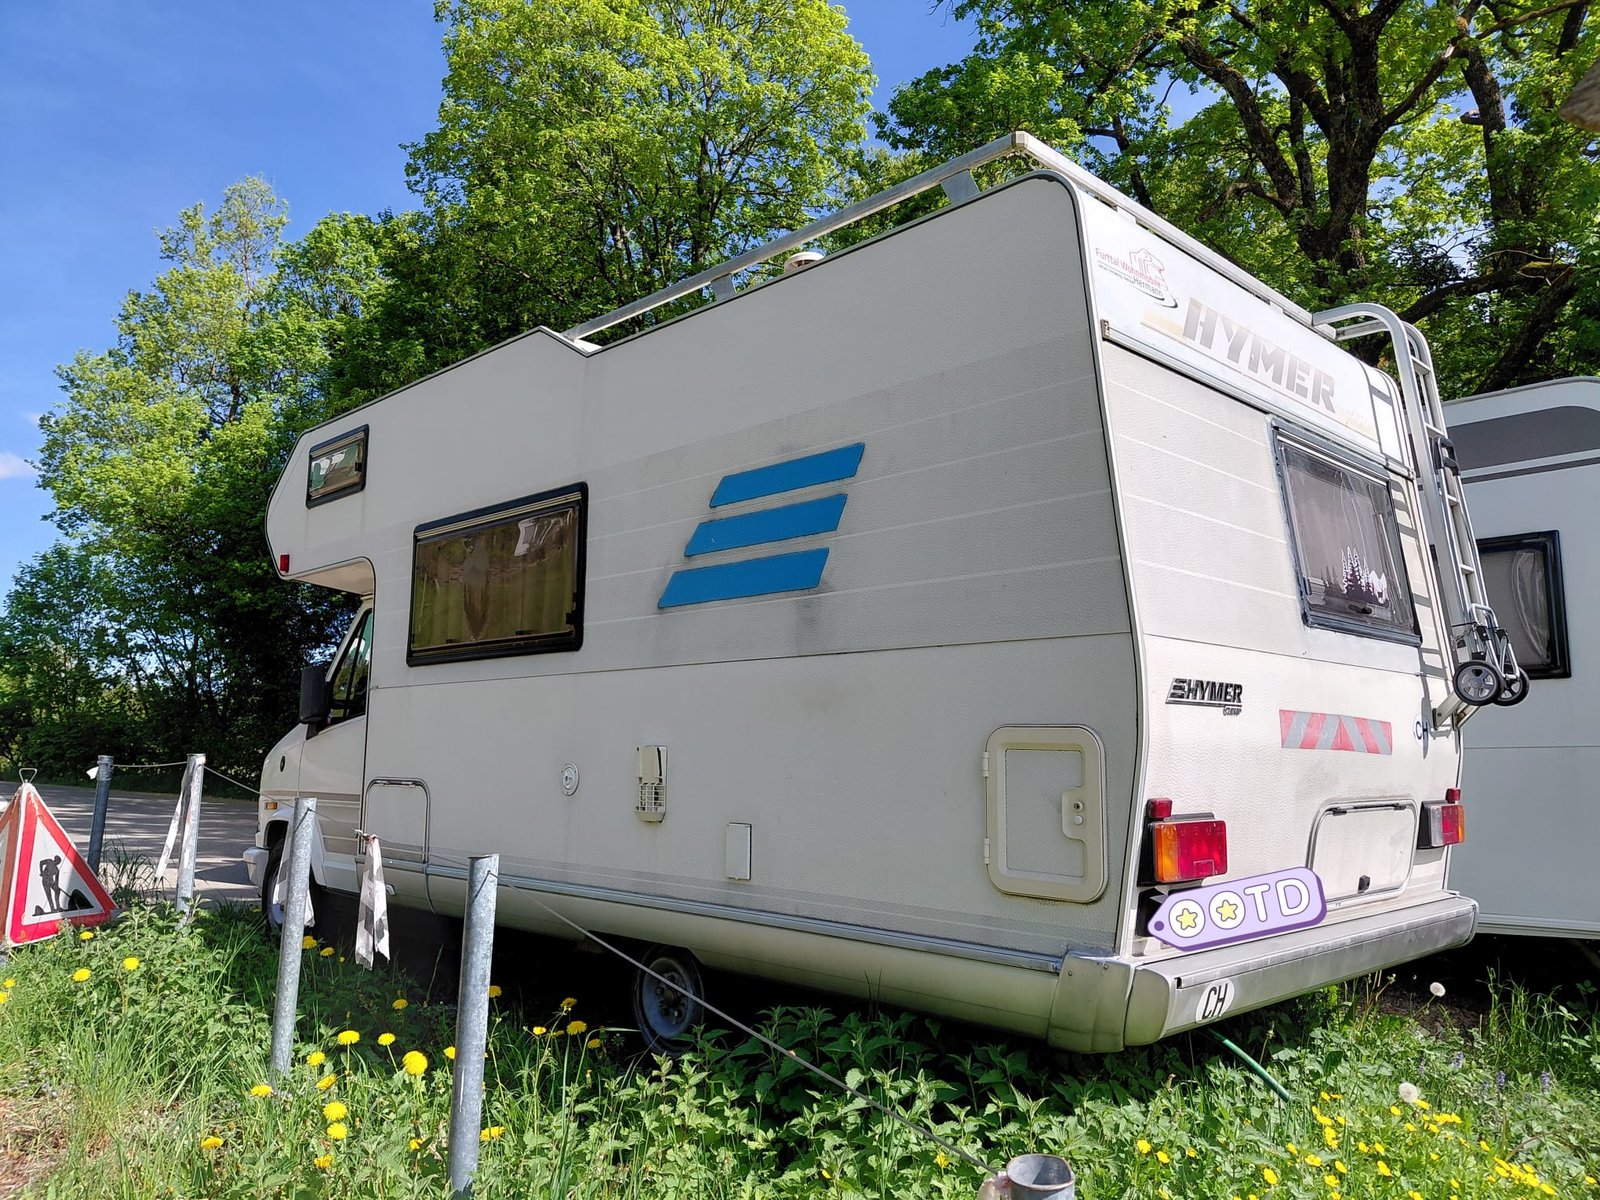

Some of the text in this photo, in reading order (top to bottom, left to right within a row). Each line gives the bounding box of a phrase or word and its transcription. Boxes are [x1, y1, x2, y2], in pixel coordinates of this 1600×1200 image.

[1182, 297, 1336, 413] HYMER
[1185, 678, 1242, 704] HYMER
[1201, 983, 1229, 1020] CH
